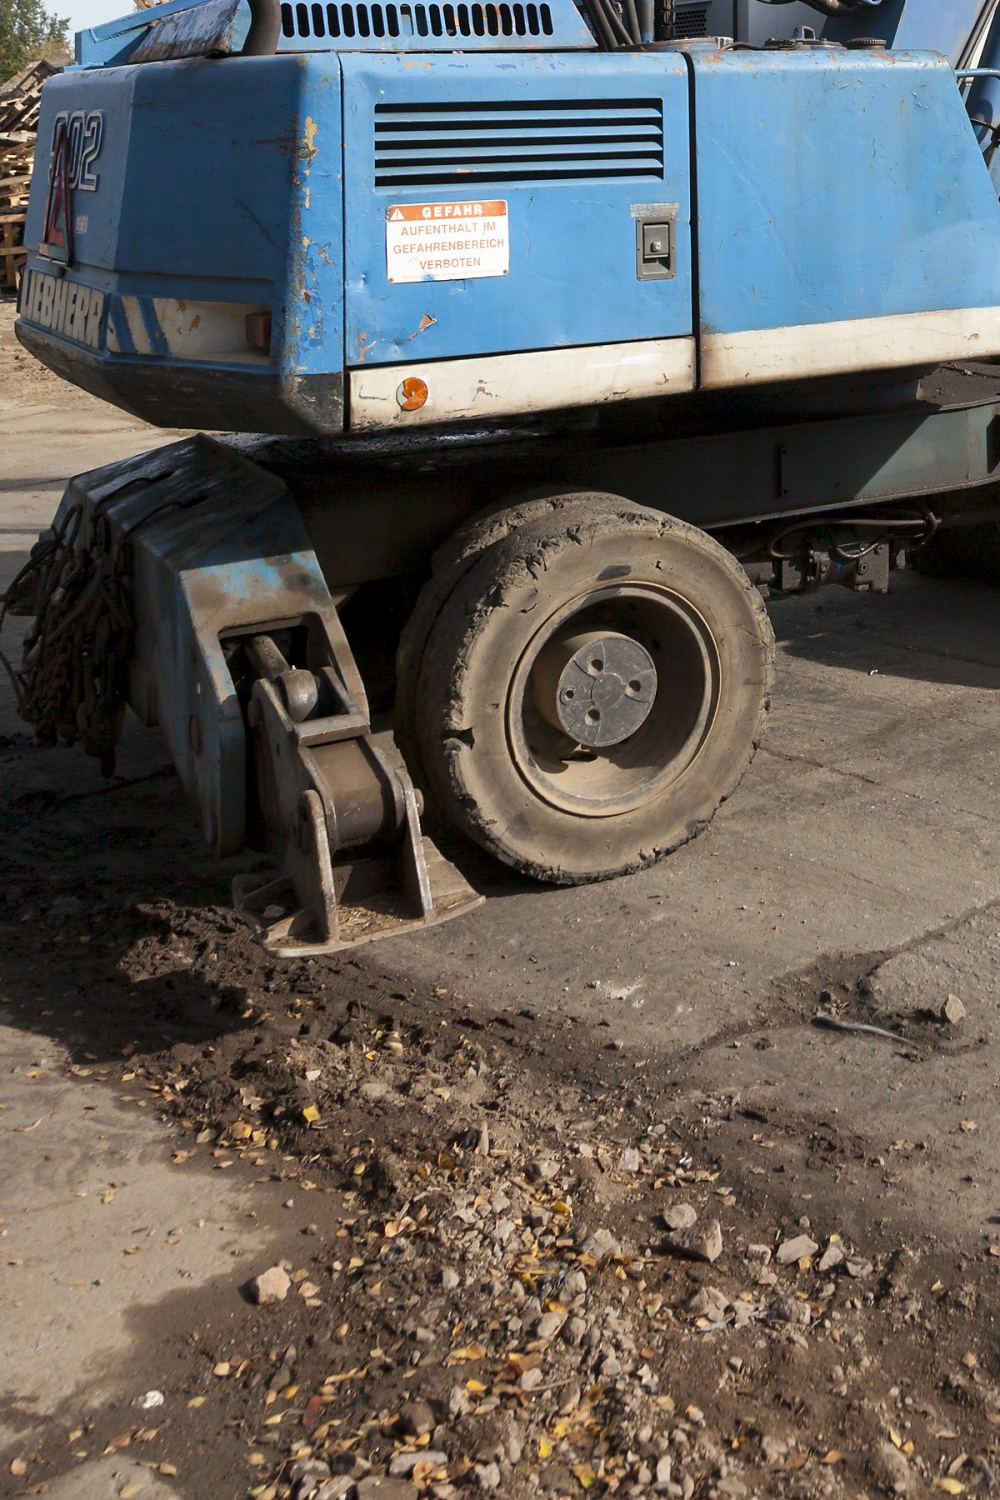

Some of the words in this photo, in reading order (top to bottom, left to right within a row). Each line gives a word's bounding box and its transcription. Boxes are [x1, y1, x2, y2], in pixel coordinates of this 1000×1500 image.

[422, 204, 483, 218] GEFAHR
[401, 222, 478, 236] AUFENTHALT
[483, 221, 496, 232] IM
[393, 238, 504, 254] GEFAHRENBEREICH
[420, 257, 480, 270] VERBOTEN
[20, 268, 104, 349] LIEBHERR
